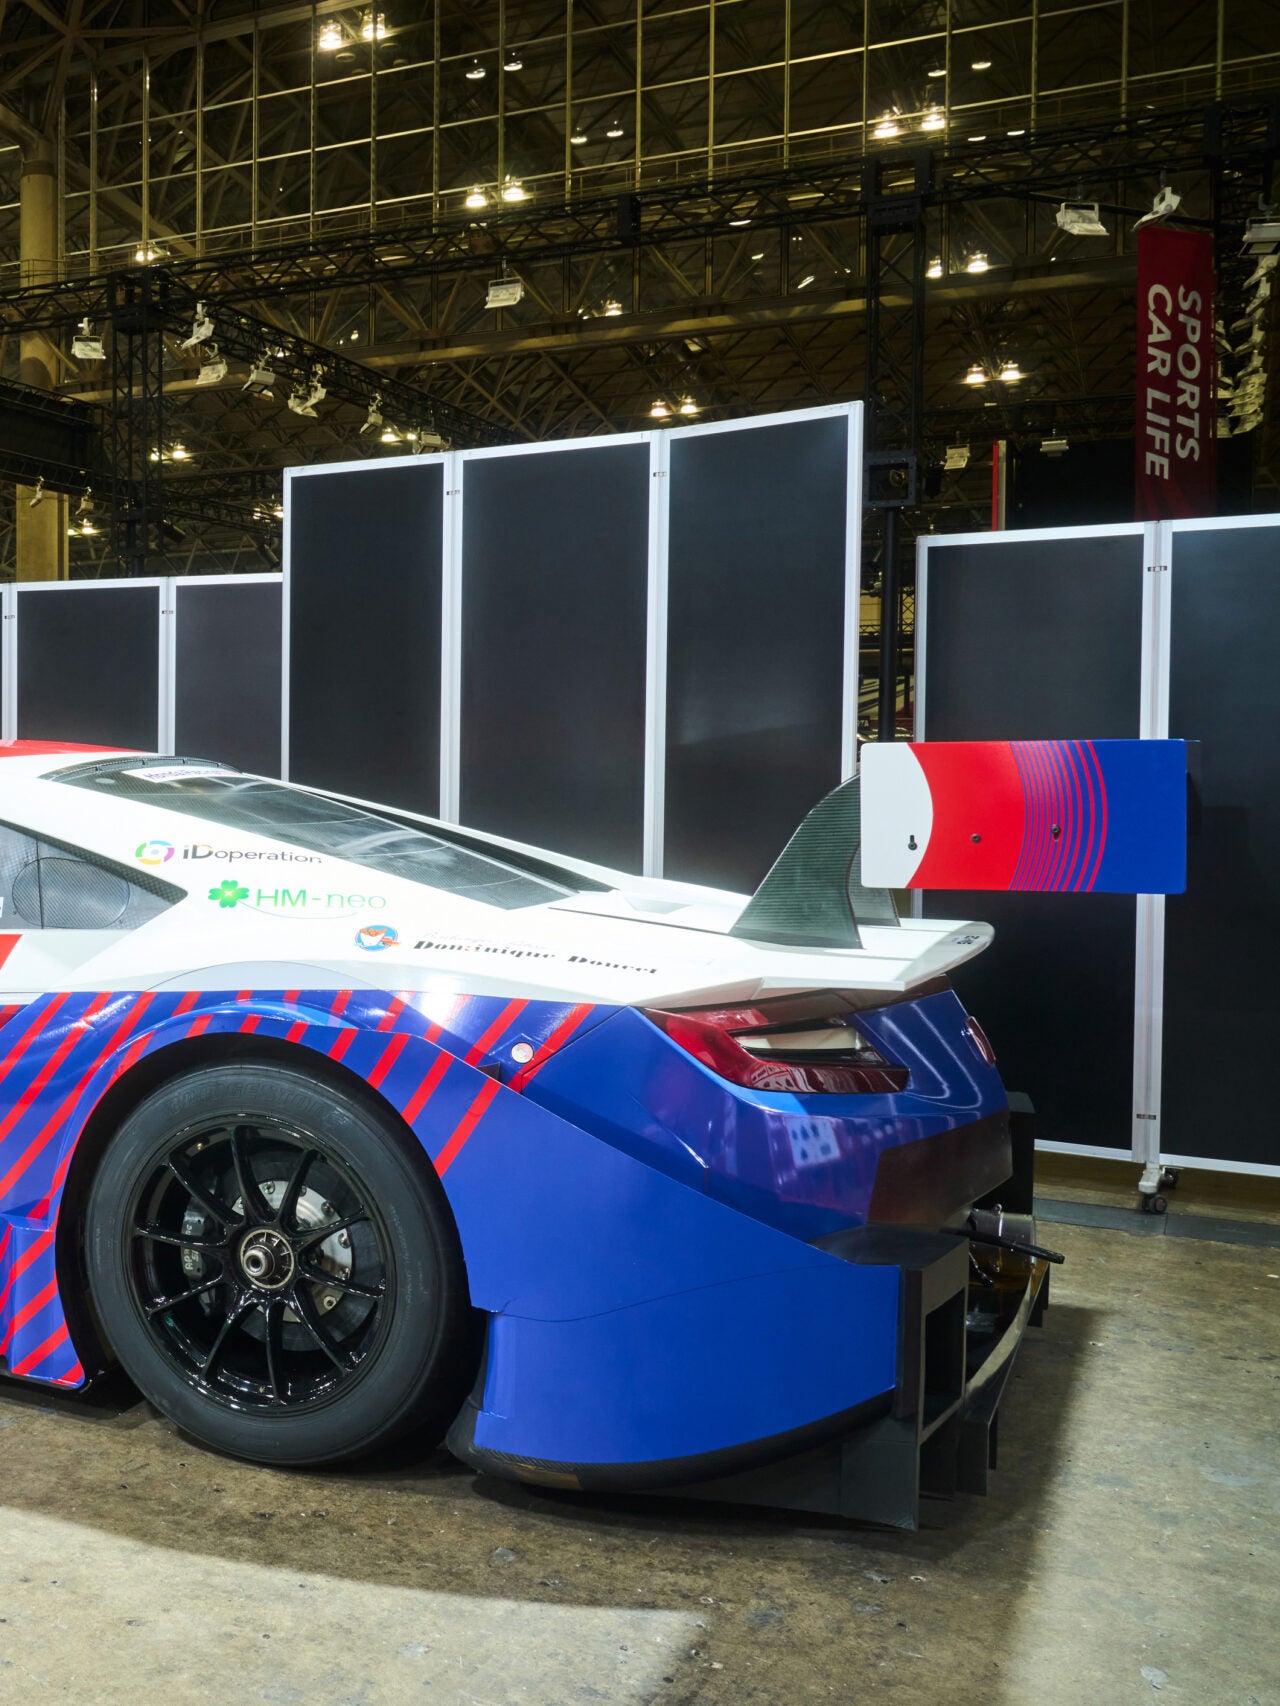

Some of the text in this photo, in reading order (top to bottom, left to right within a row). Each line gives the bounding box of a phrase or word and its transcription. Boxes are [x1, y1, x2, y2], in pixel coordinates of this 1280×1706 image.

[1145, 284, 1173, 480] CAR LIFE
[1176, 284, 1202, 462] SPORTS
[183, 843, 323, 863] iDoperation
[256, 888, 387, 910] HM-neo
